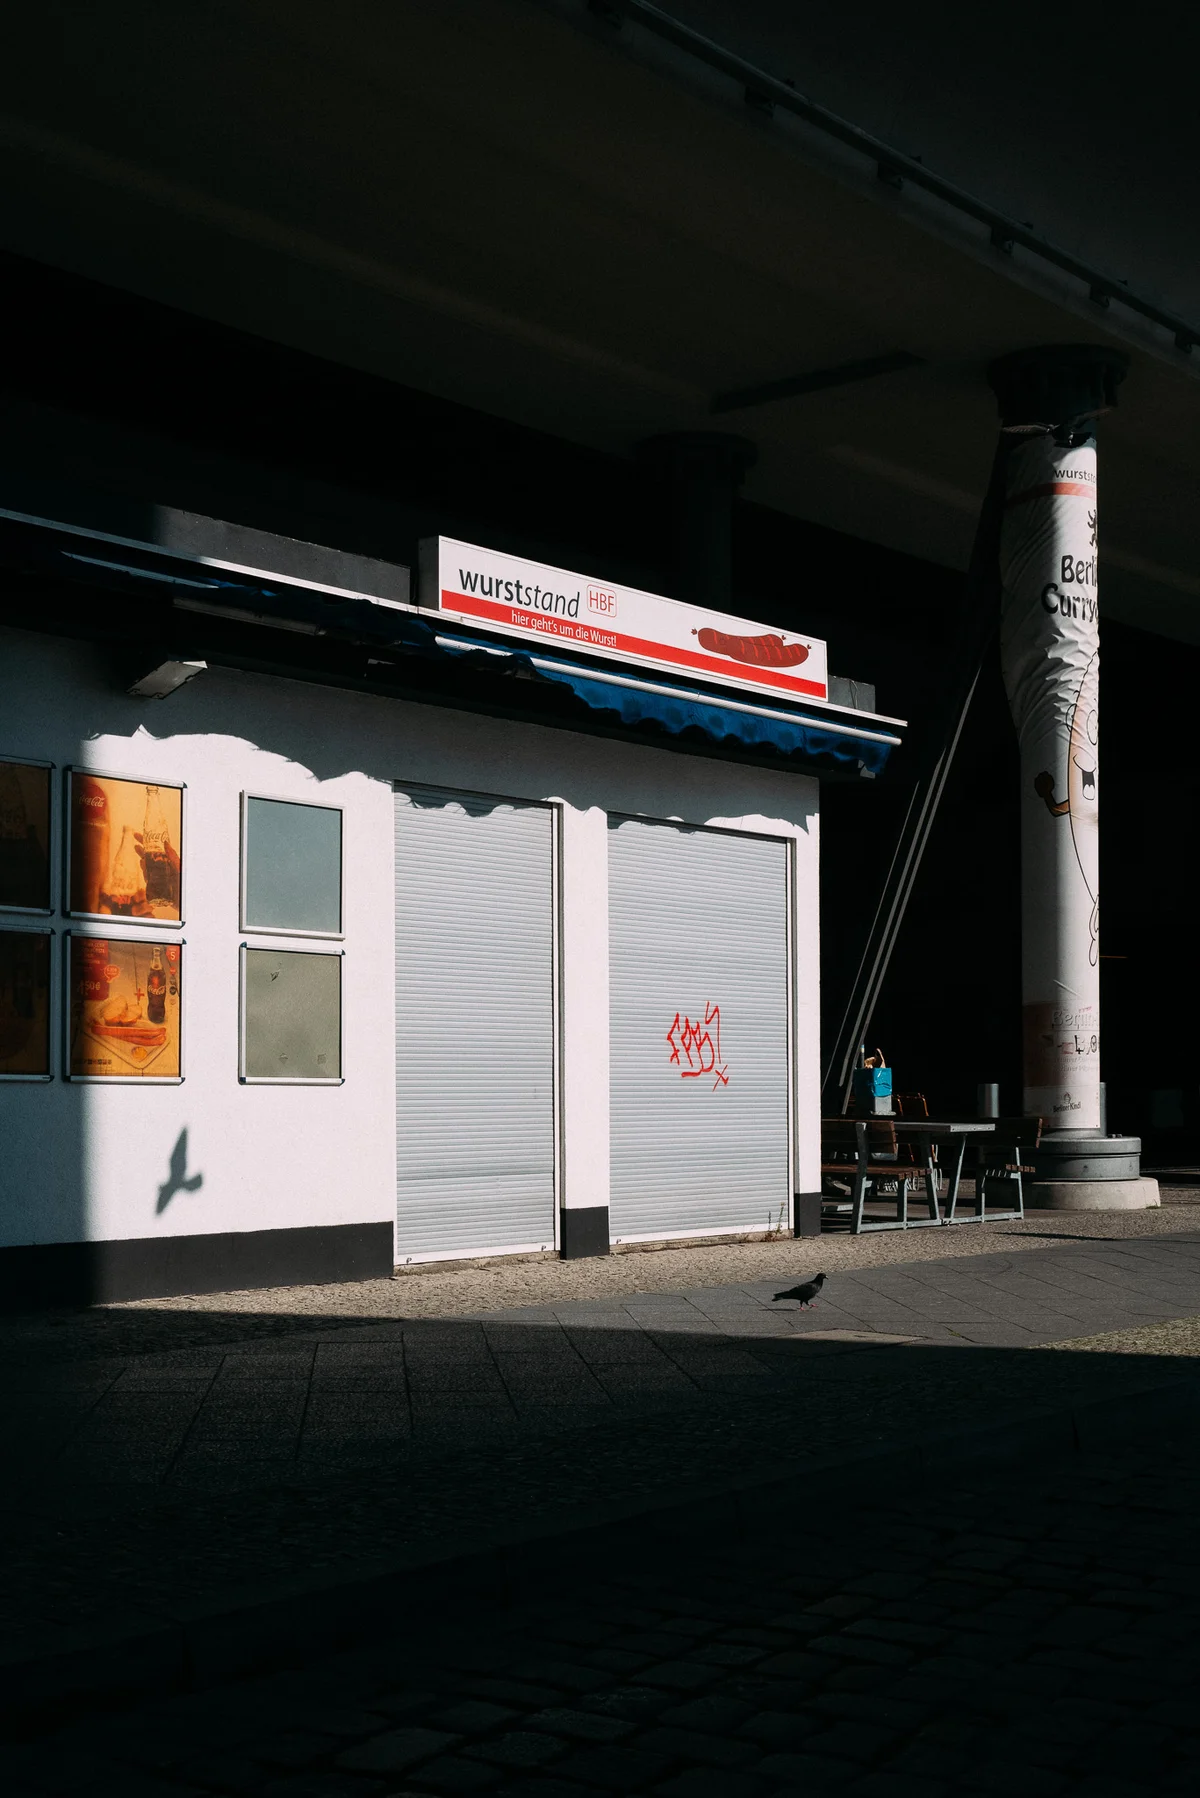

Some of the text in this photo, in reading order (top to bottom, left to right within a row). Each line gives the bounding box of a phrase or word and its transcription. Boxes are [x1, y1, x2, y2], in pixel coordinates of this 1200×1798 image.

[458, 568, 615, 618] wurststand HBF
[511, 609, 529, 626] hier
[559, 626, 574, 637] um
[576, 627, 588, 641] die
[590, 631, 617, 647] Wurst!
